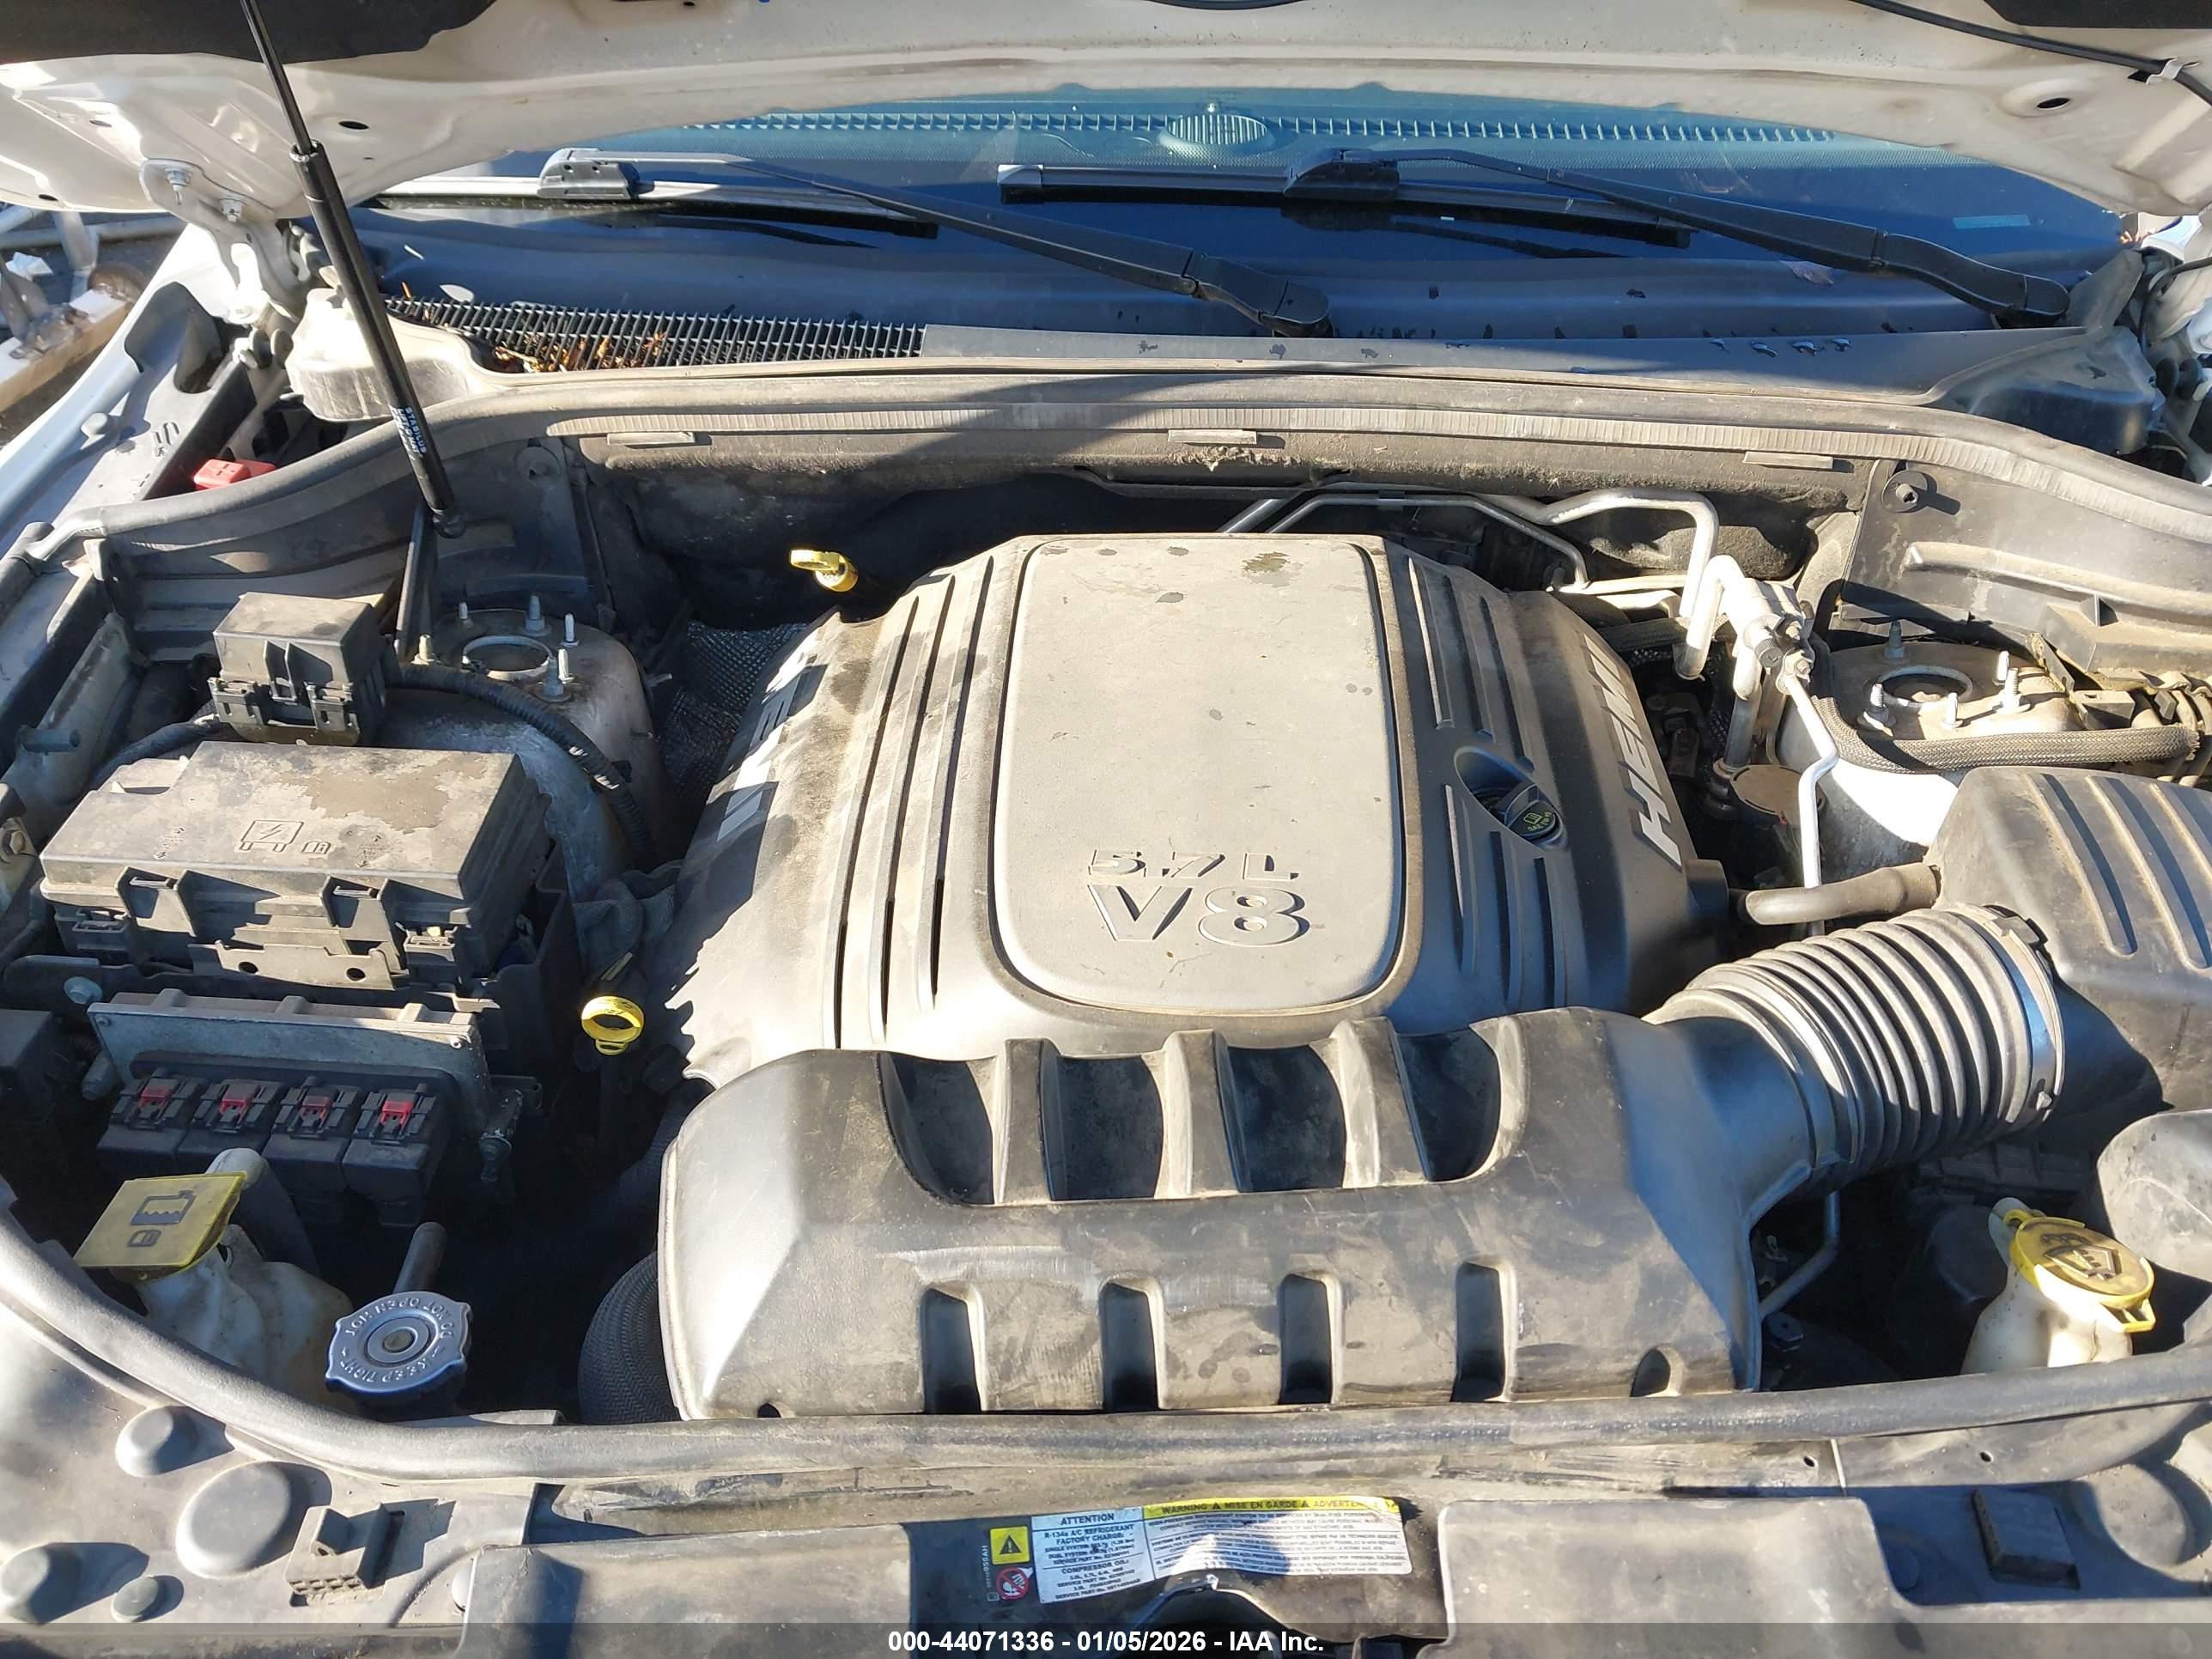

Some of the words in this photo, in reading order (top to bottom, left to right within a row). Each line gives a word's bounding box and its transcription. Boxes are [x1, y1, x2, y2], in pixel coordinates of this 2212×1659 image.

[1585, 634, 1682, 869] HEMI
[1087, 884, 1310, 947] V8
[375, 1297, 421, 1314] OPEN
[345, 1311, 373, 1336] HOT
[1163, 1504, 1207, 1514] WARNING
[1266, 1500, 1298, 1509] GARDE
[1060, 1514, 1115, 1525] ATTENTION
[1085, 1524, 1134, 1534] REFRIGERANT
[1056, 1536, 1091, 1545] FACTORY
[1061, 1563, 1112, 1574] COMPRESSOR
